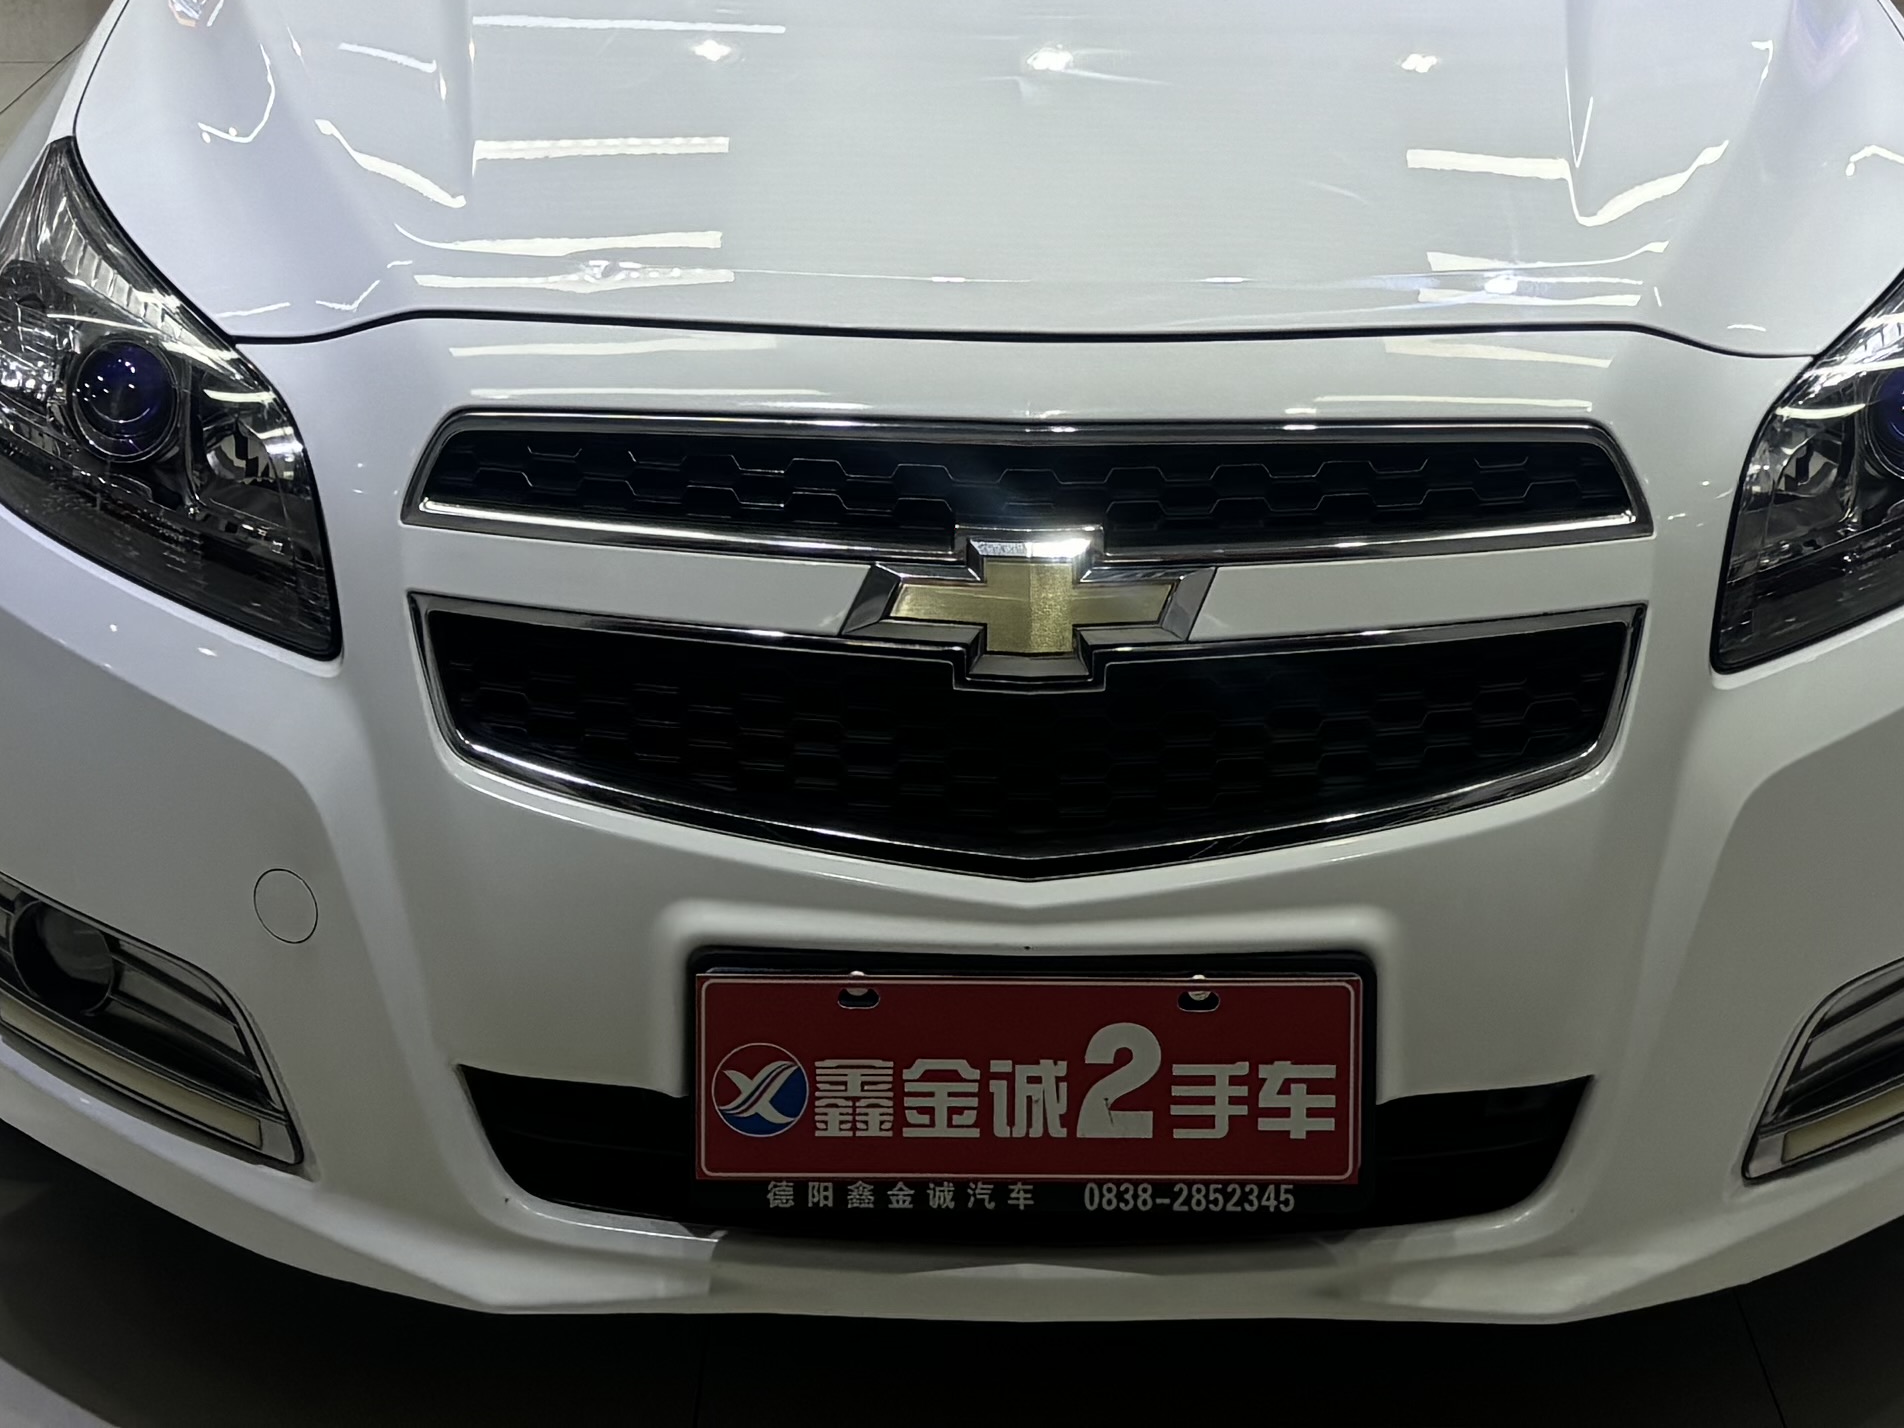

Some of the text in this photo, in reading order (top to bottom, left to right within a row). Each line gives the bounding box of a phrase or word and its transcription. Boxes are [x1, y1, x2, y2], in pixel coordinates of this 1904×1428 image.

[814, 1022, 1337, 1139] 鑫金诚2手车
[766, 1180, 1296, 1213] 德阳鑫金诚汽车 0838-2852345
